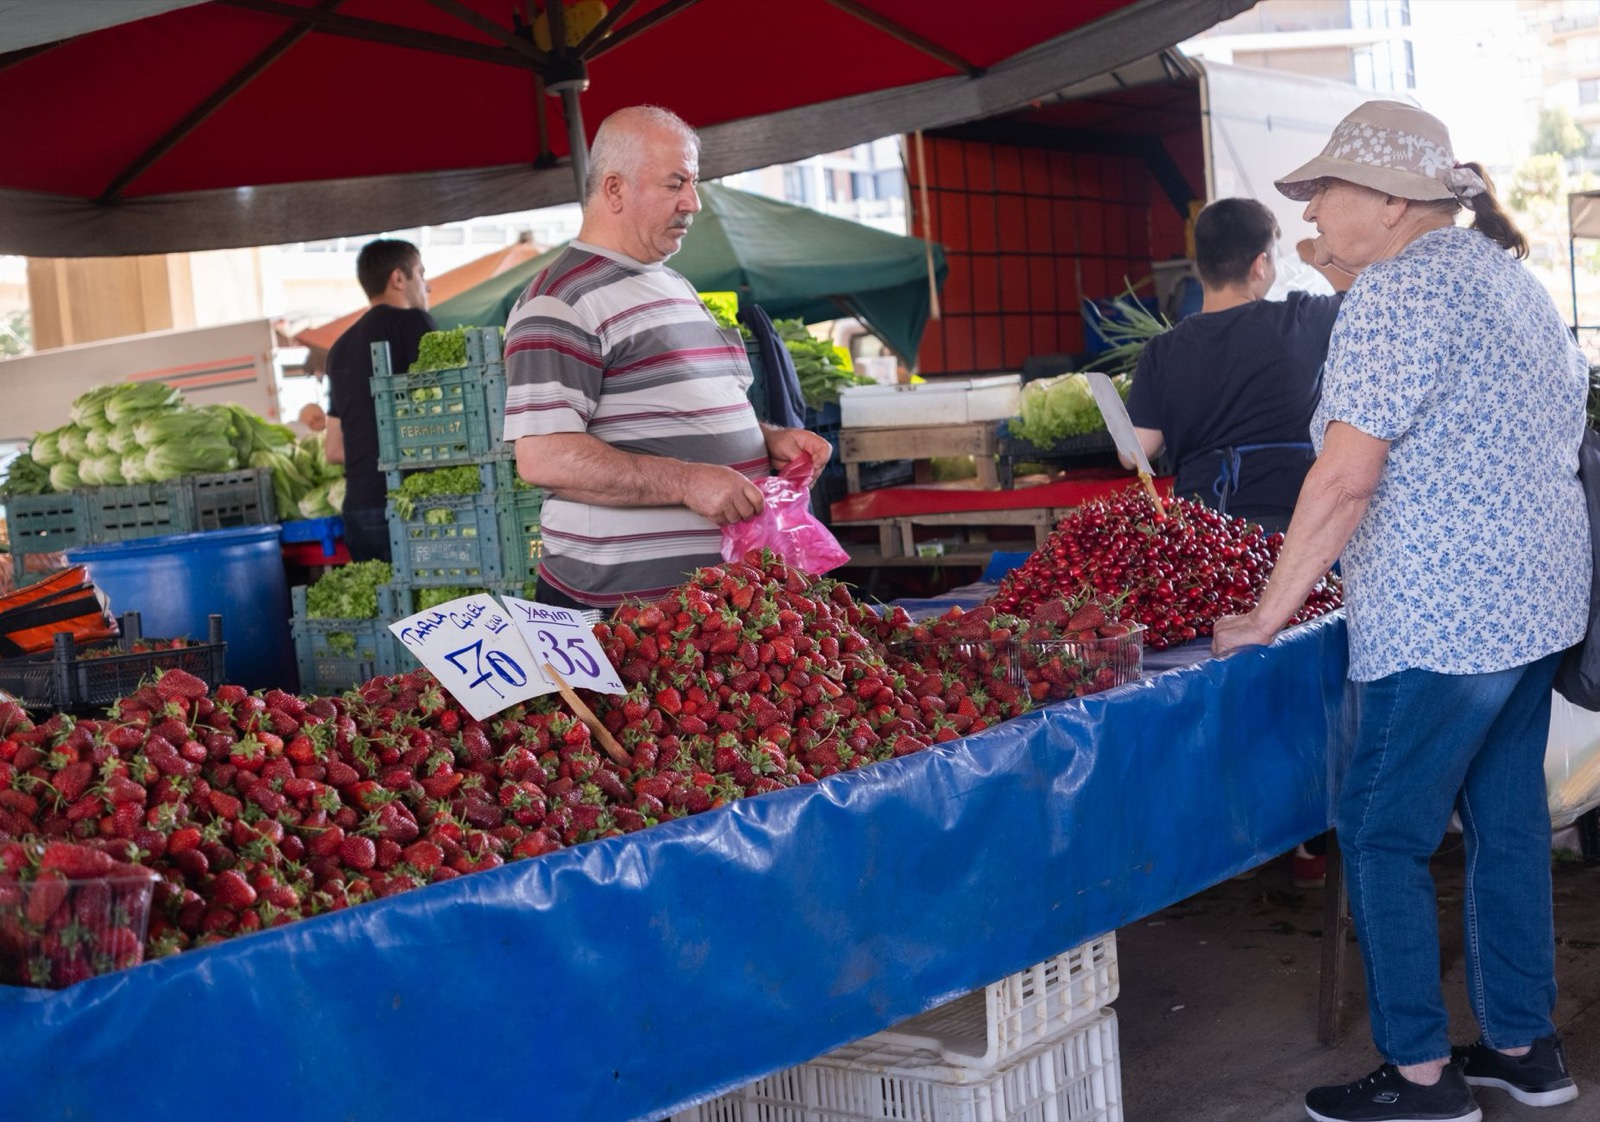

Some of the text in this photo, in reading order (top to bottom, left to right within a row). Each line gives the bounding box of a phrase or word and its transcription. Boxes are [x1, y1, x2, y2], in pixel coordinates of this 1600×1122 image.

[401, 611, 448, 646] TARLA
[514, 603, 575, 623] YARIM
[444, 638, 527, 699] 70
[537, 629, 601, 679] 35
